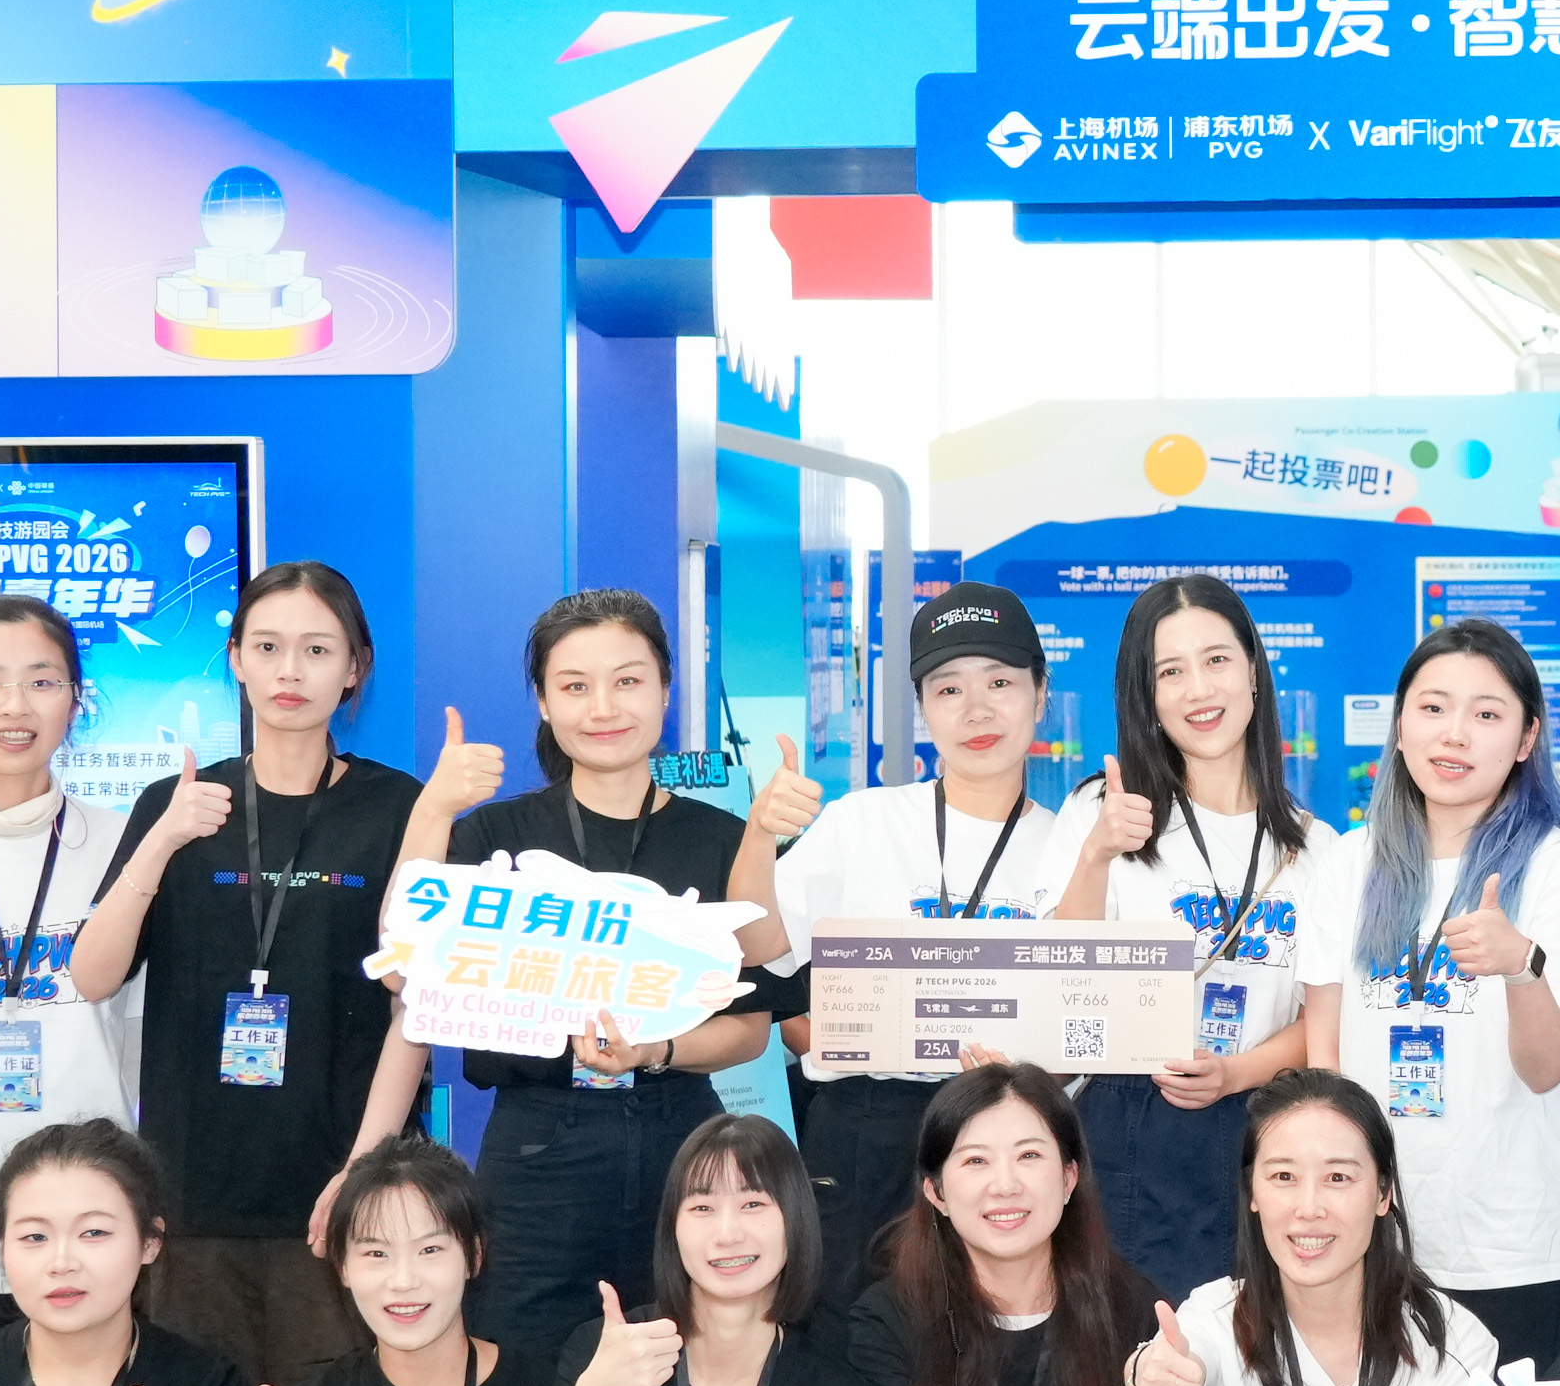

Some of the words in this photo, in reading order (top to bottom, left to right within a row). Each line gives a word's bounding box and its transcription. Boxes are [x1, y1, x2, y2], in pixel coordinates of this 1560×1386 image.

[1053, 116, 1158, 140] 上海机场
[1183, 113, 1294, 139] 浦东机场
[1349, 118, 1485, 153] VariFlight
[1053, 143, 1158, 160] AVINEX
[1208, 141, 1264, 160] PVG
[1295, 427, 1338, 435] Passenger
[1396, 427, 1428, 435] Station
[56, 544, 127, 572] 2026
[1060, 582, 1081, 592] Vote
[1083, 582, 1104, 591] with
[936, 608, 964, 623] TECH
[968, 606, 992, 617] PVG
[947, 612, 980, 623] 2026
[295, 872, 321, 880] PVG
[405, 877, 631, 945] 今日身份
[865, 947, 893, 961] 25A
[911, 947, 975, 963] VariFlight
[1014, 946, 1087, 964] 云端出发
[1095, 946, 1168, 964] 智慧出行
[445, 942, 680, 1008] 云端旅客
[926, 978, 949, 986] TECH
[952, 978, 971, 986] PVG
[974, 978, 997, 986] 2026
[823, 985, 854, 994] VF666
[873, 986, 885, 994] 06
[419, 989, 454, 1011] My
[463, 994, 535, 1018] Cloud
[822, 1003, 828, 1011] 5
[832, 1003, 854, 1011] AUG
[857, 1003, 881, 1011] 2026
[1062, 994, 1109, 1006] VF666
[1139, 994, 1156, 1006] 06
[923, 1003, 951, 1013] 飞常准
[991, 1004, 1009, 1013] 浦东
[415, 1015, 488, 1039] Starts
[498, 1024, 555, 1046] Here
[915, 1024, 921, 1033] 5
[924, 1024, 947, 1033] AUG
[950, 1024, 974, 1033] 2026
[1204, 1022, 1242, 1037] 工作证
[231, 1029, 278, 1044] 工作证
[923, 1042, 951, 1056] 25A
[1395, 1066, 1436, 1080] 工作证
